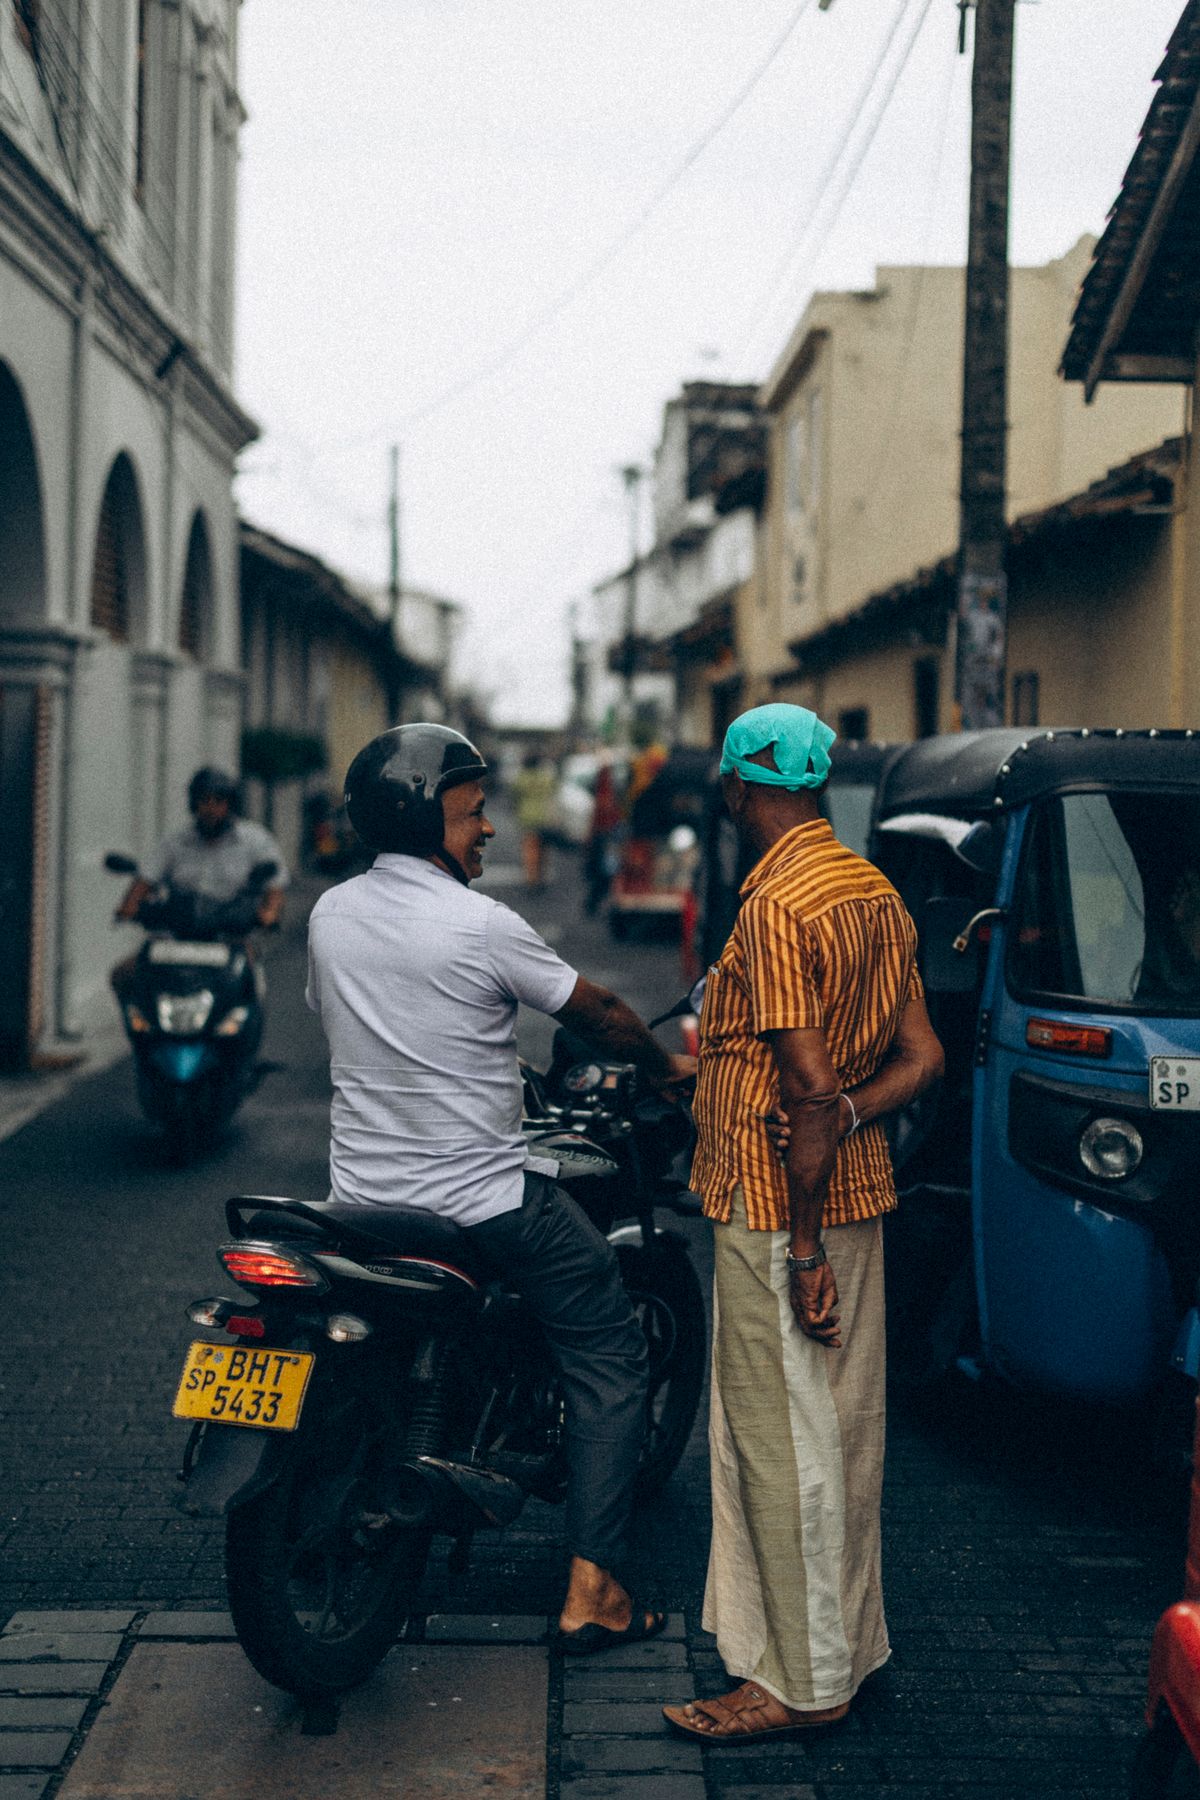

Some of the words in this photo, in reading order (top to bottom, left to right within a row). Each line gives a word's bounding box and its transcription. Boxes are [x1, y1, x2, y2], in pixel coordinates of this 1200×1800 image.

[1158, 1081, 1190, 1104] SP
[185, 1368, 217, 1392] SP
[226, 1350, 291, 1387] BHT
[210, 1386, 283, 1424] 5433
